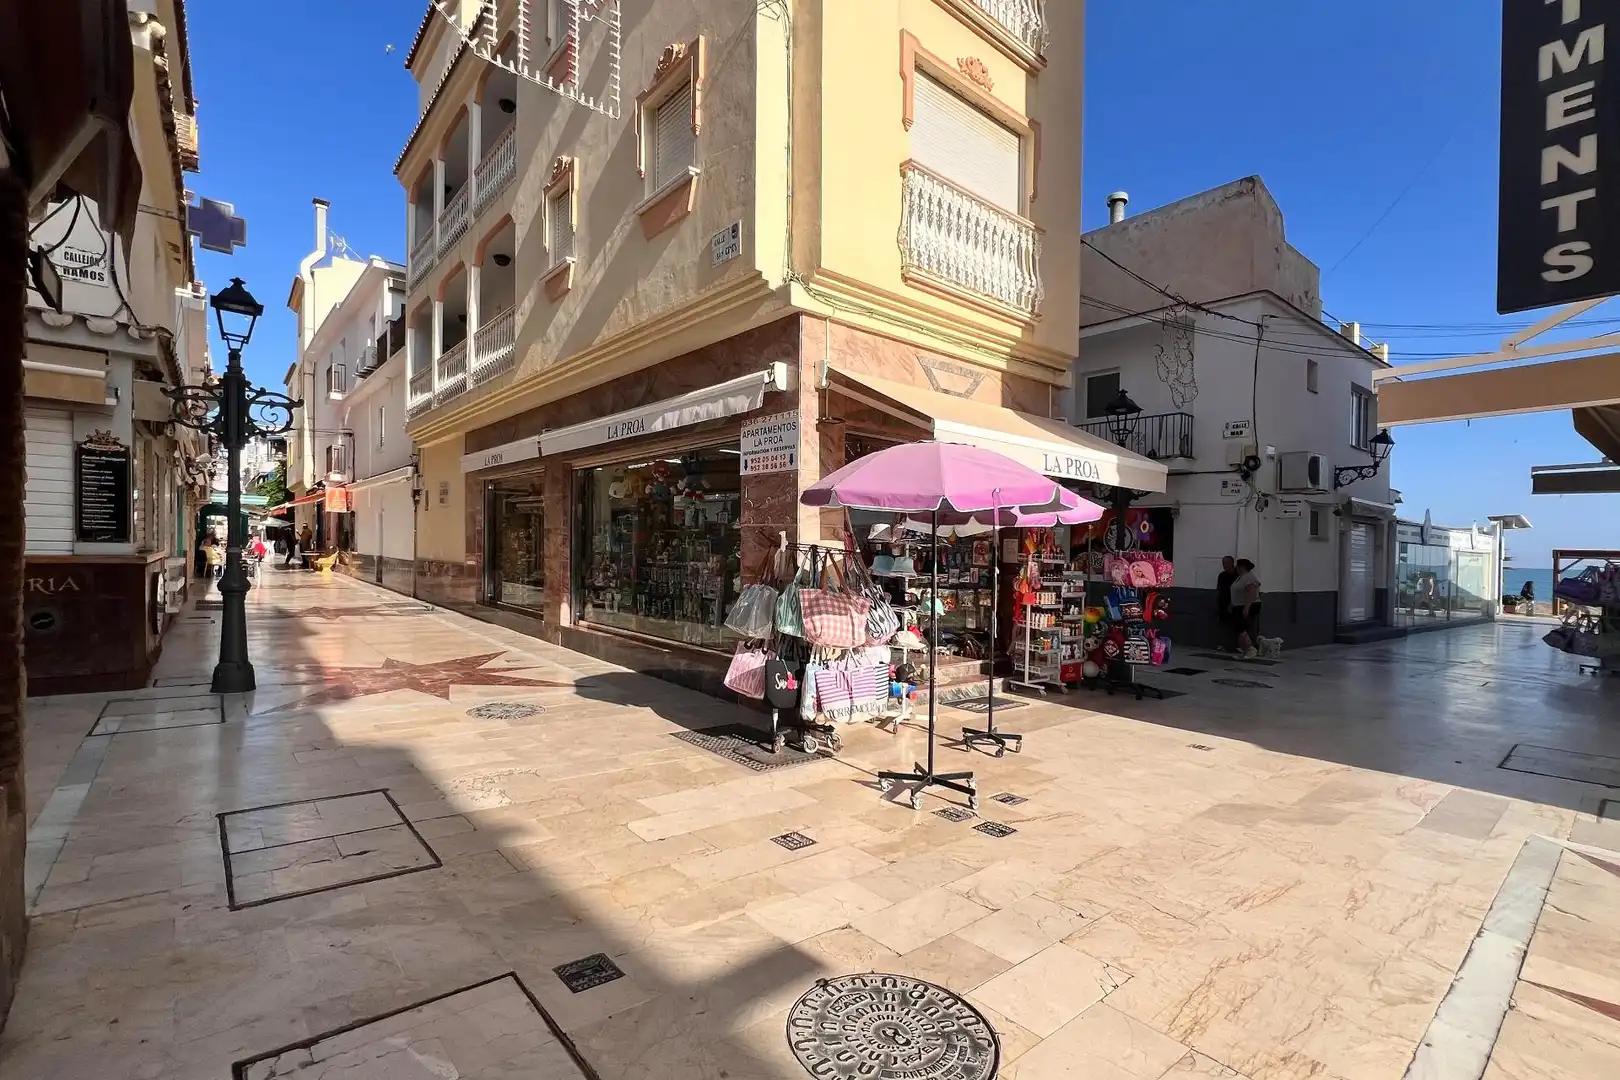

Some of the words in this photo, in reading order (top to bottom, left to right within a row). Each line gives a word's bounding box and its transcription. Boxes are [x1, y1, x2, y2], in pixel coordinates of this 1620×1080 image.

[63, 267, 105, 282] RAMOS
[607, 425, 619, 440] LA
[620, 418, 645, 437] PROA
[742, 421, 797, 439] APARTAMENTOS
[753, 438, 763, 448] LA
[764, 435, 783, 446] PROA
[1042, 453, 1062, 473] LA
[1065, 457, 1100, 480] PROA
